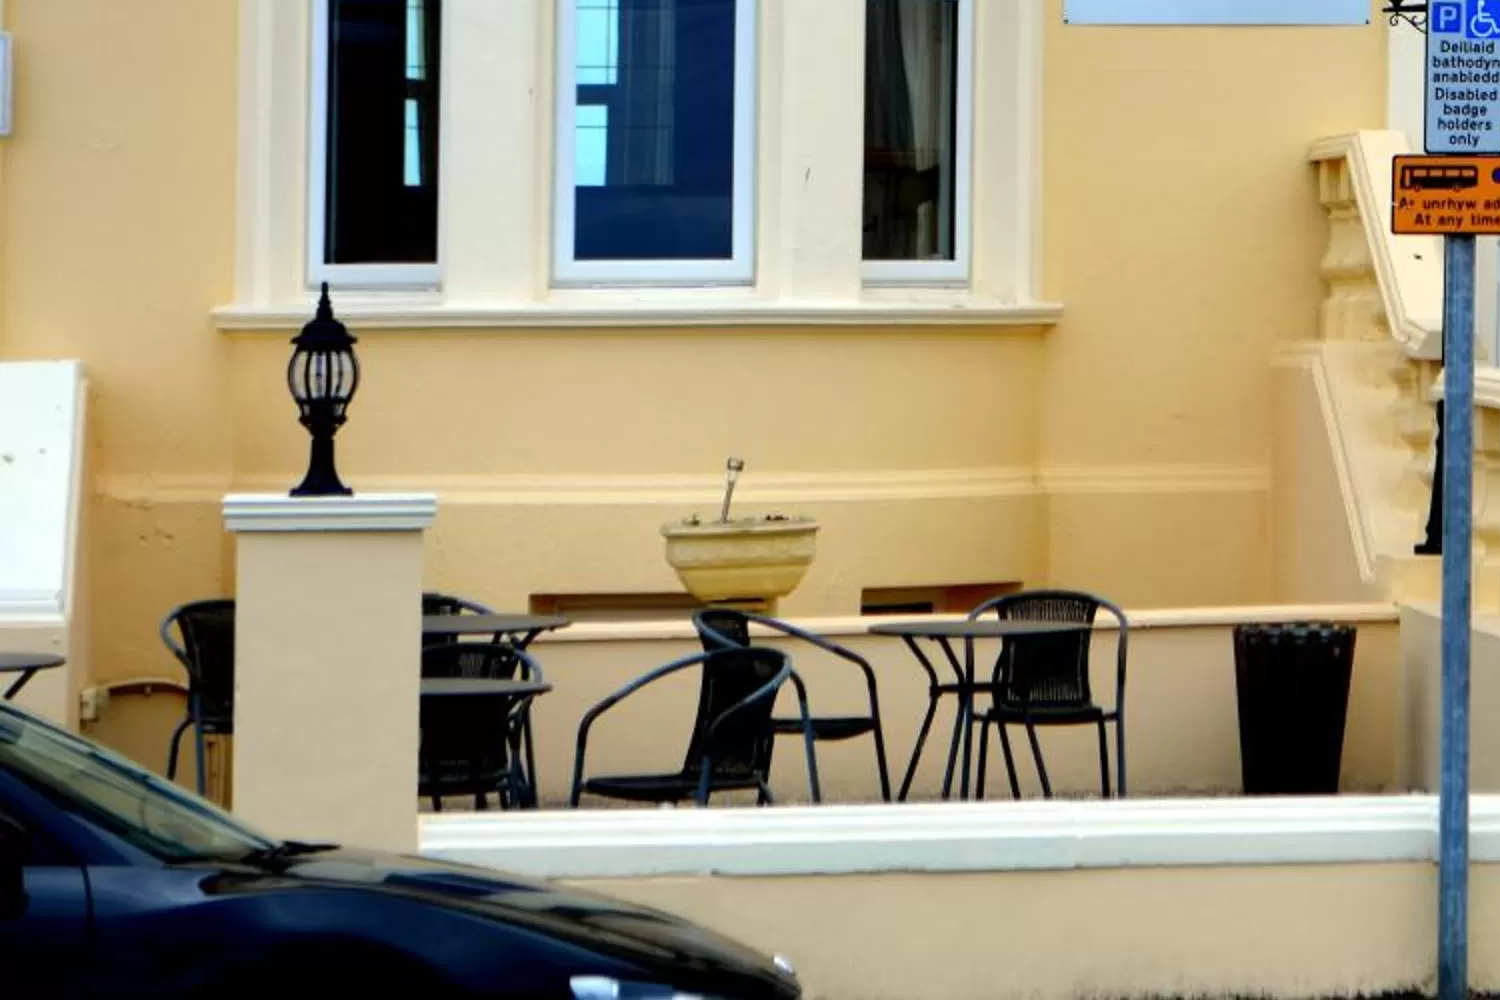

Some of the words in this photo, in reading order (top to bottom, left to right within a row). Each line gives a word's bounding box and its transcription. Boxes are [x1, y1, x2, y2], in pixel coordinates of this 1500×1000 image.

[1440, 6, 1457, 29] P
[1440, 40, 1495, 54] Deiliaid
[1432, 55, 1500, 70] bathodyn
[1433, 71, 1500, 83] anabledd
[1435, 87, 1498, 101] Disabled
[1443, 102, 1488, 118] badge
[1437, 116, 1492, 131] holders
[1449, 132, 1480, 147] only
[1423, 198, 1477, 212] unrhyw
[1414, 212, 1432, 225] At
[1438, 215, 1463, 228] any
